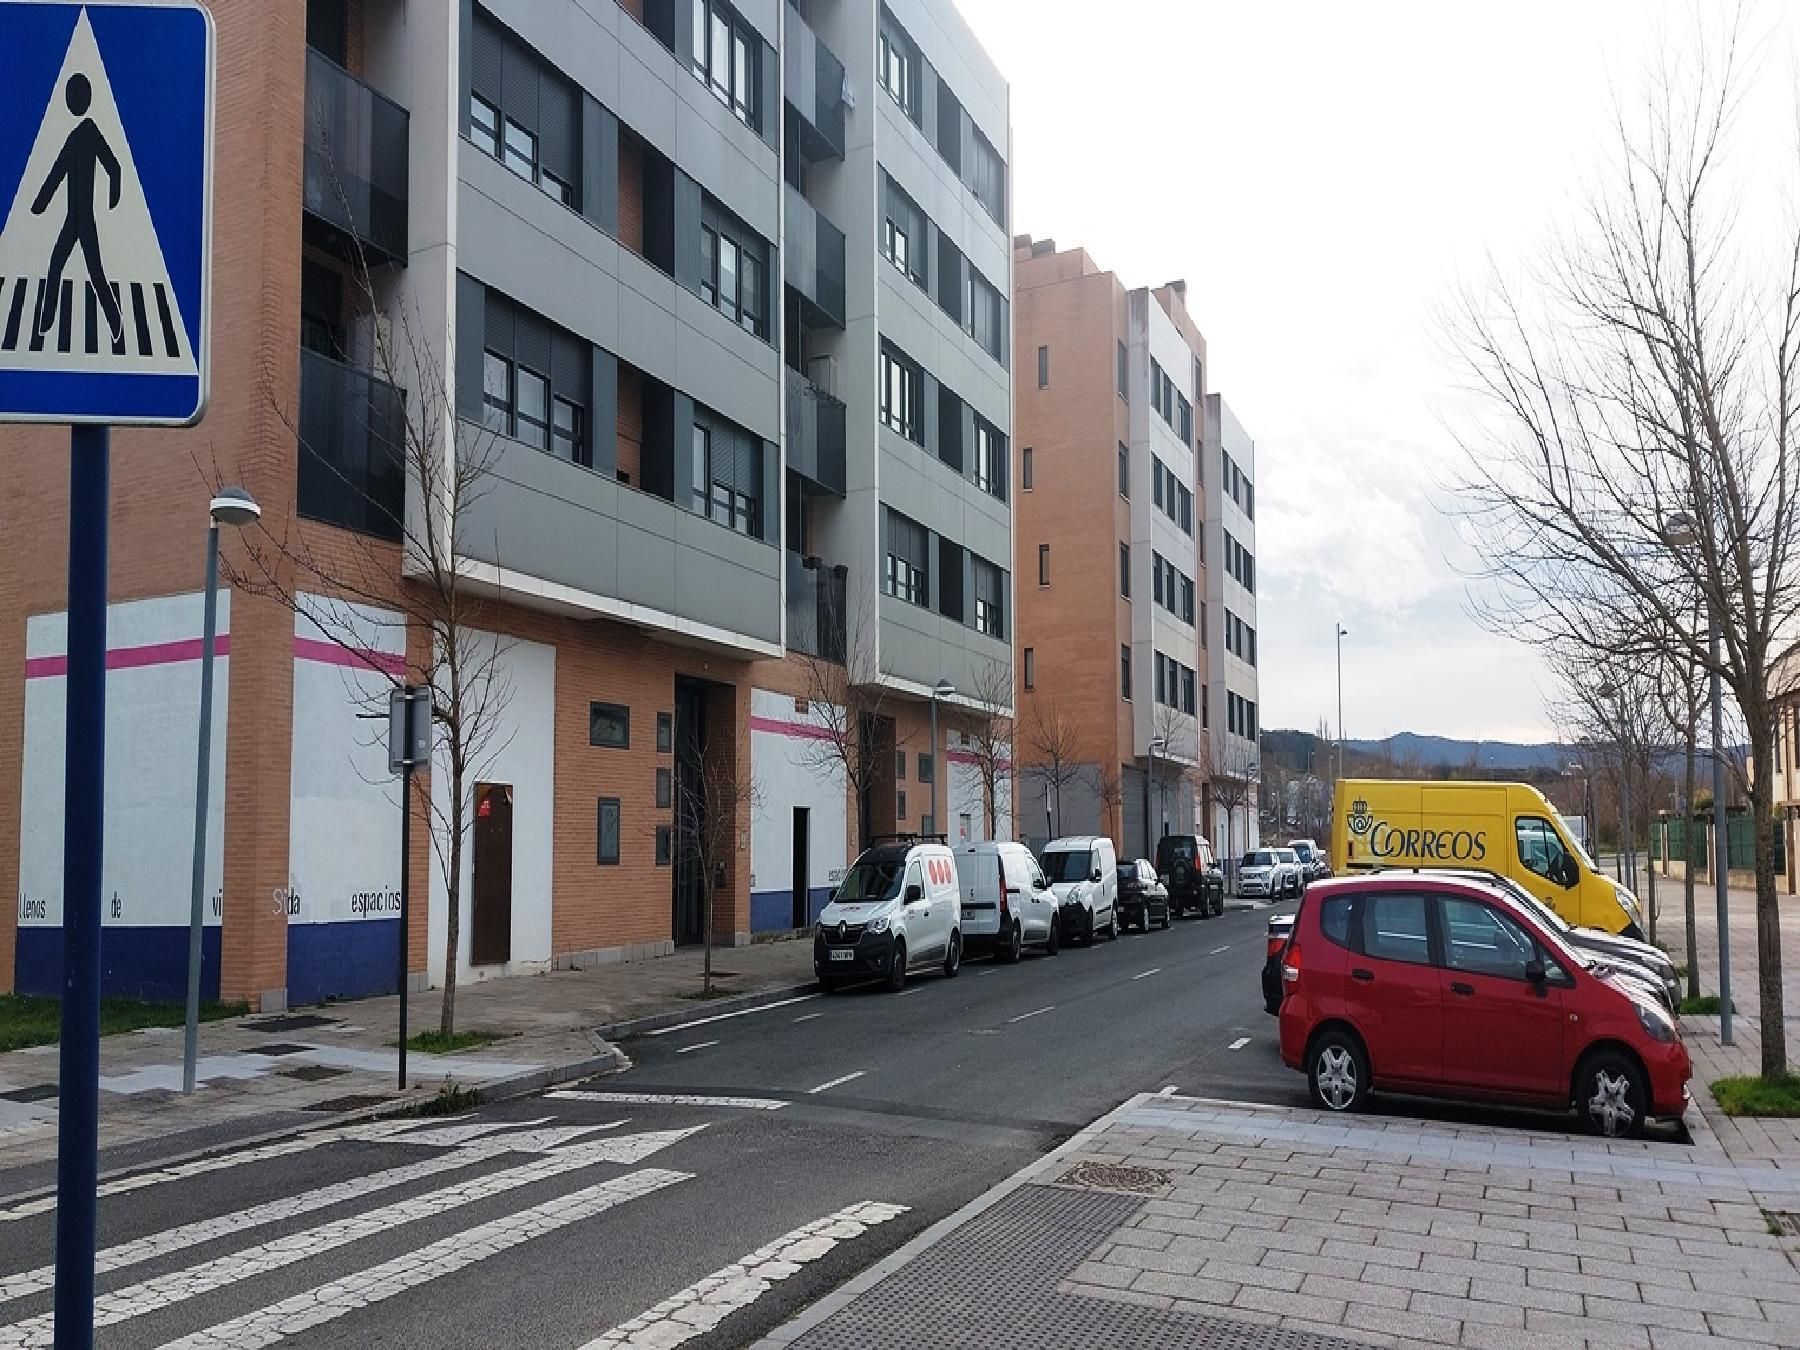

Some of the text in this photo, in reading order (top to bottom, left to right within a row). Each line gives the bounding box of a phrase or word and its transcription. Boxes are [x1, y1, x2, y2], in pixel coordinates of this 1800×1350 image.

[1371, 821, 1487, 861] CORREOS
[111, 890, 122, 919] de
[351, 884, 401, 918] espacios
